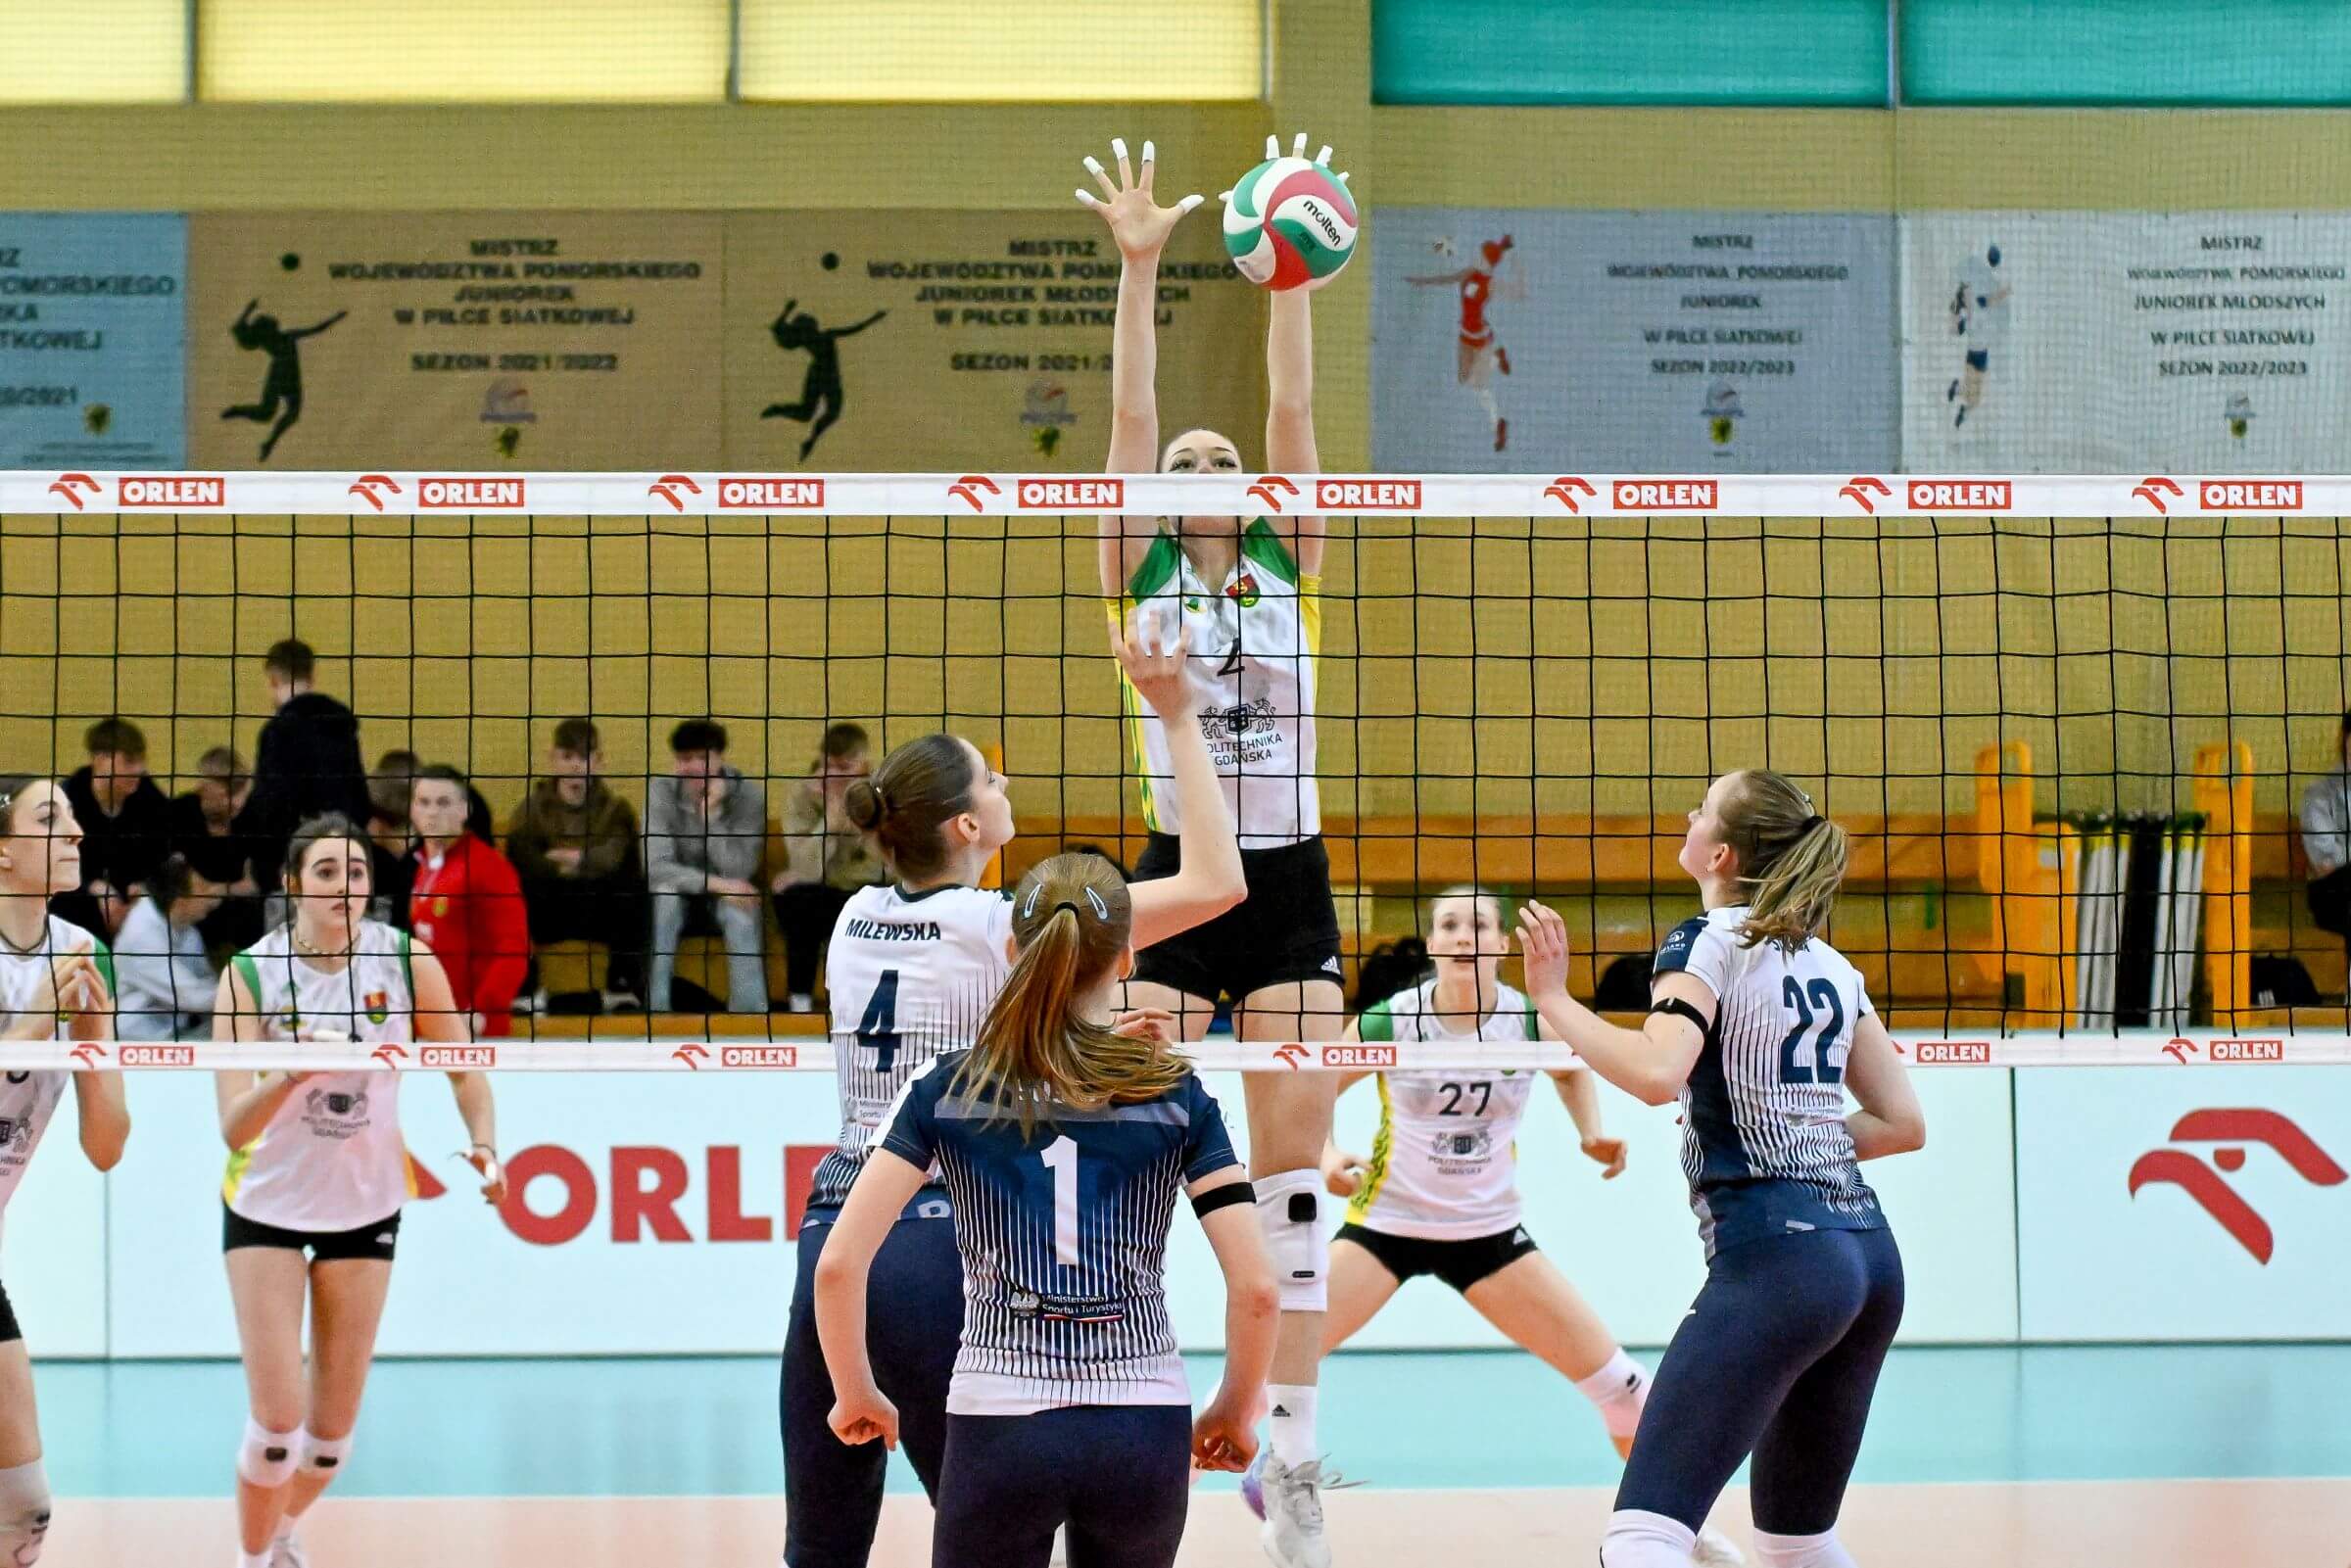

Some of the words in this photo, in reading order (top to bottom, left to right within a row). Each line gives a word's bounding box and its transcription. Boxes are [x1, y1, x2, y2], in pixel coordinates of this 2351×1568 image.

[1303, 200, 1341, 247] molten
[470, 239, 558, 257] MISTRZ
[1008, 240, 1097, 258] MISTRZ
[1693, 234, 1752, 250] MISTRZ
[2200, 235, 2263, 251] MISTRZ
[523, 262, 701, 280] POMORSKIEGO
[2240, 265, 2345, 281] POMORSKIEGO
[455, 285, 574, 303] JUNIOREK
[916, 286, 1036, 304] JUNIOREK
[1681, 294, 1762, 309] JUNIOREK
[2135, 295, 2217, 310] JUNIOREK
[394, 309, 414, 325] W
[500, 309, 635, 325] SIATKOWEJ
[934, 309, 953, 326] W
[1644, 329, 1661, 344] W
[1714, 329, 1802, 345] SIATKOWEJ
[2151, 330, 2167, 346] W
[2223, 330, 2315, 347] SIATKOWEJ
[411, 354, 490, 371] SEZON
[950, 354, 1029, 371] SEZON
[1652, 359, 1704, 374] SEZON
[1708, 359, 1795, 376] 2022/2023
[2158, 360, 2213, 376] SEZON
[2219, 360, 2308, 378] 2022/2023
[123, 482, 218, 502] ORLEN
[423, 483, 518, 503] ORLEN
[723, 484, 818, 504] ORLEN
[1023, 484, 1118, 504] ORLEN
[1321, 485, 1415, 505] ORLEN
[1618, 485, 1711, 505] ORLEN
[1913, 485, 2005, 506] ORLEN
[2205, 485, 2297, 506] ORLEN
[1214, 637, 1246, 676] 2
[1206, 734, 1283, 753] OLITECHNIKA
[1215, 749, 1272, 765] GDAŃSKA
[845, 919, 941, 940] MILEWSKA
[856, 970, 902, 1072] 4
[1780, 975, 1844, 1083] 22
[122, 1048, 190, 1065] ORLEN
[424, 1049, 491, 1065] ORLEN
[724, 1049, 792, 1066] ORLEN
[1325, 1049, 1392, 1065] ORLEN
[1919, 1045, 1987, 1062] ORLEN
[2213, 1043, 2279, 1059] ORLEN
[1438, 1081, 1492, 1117] 27
[497, 1144, 840, 1246] ORL
[1040, 1135, 1079, 1265] 1
[1042, 1294, 1105, 1304] Ministerstwo
